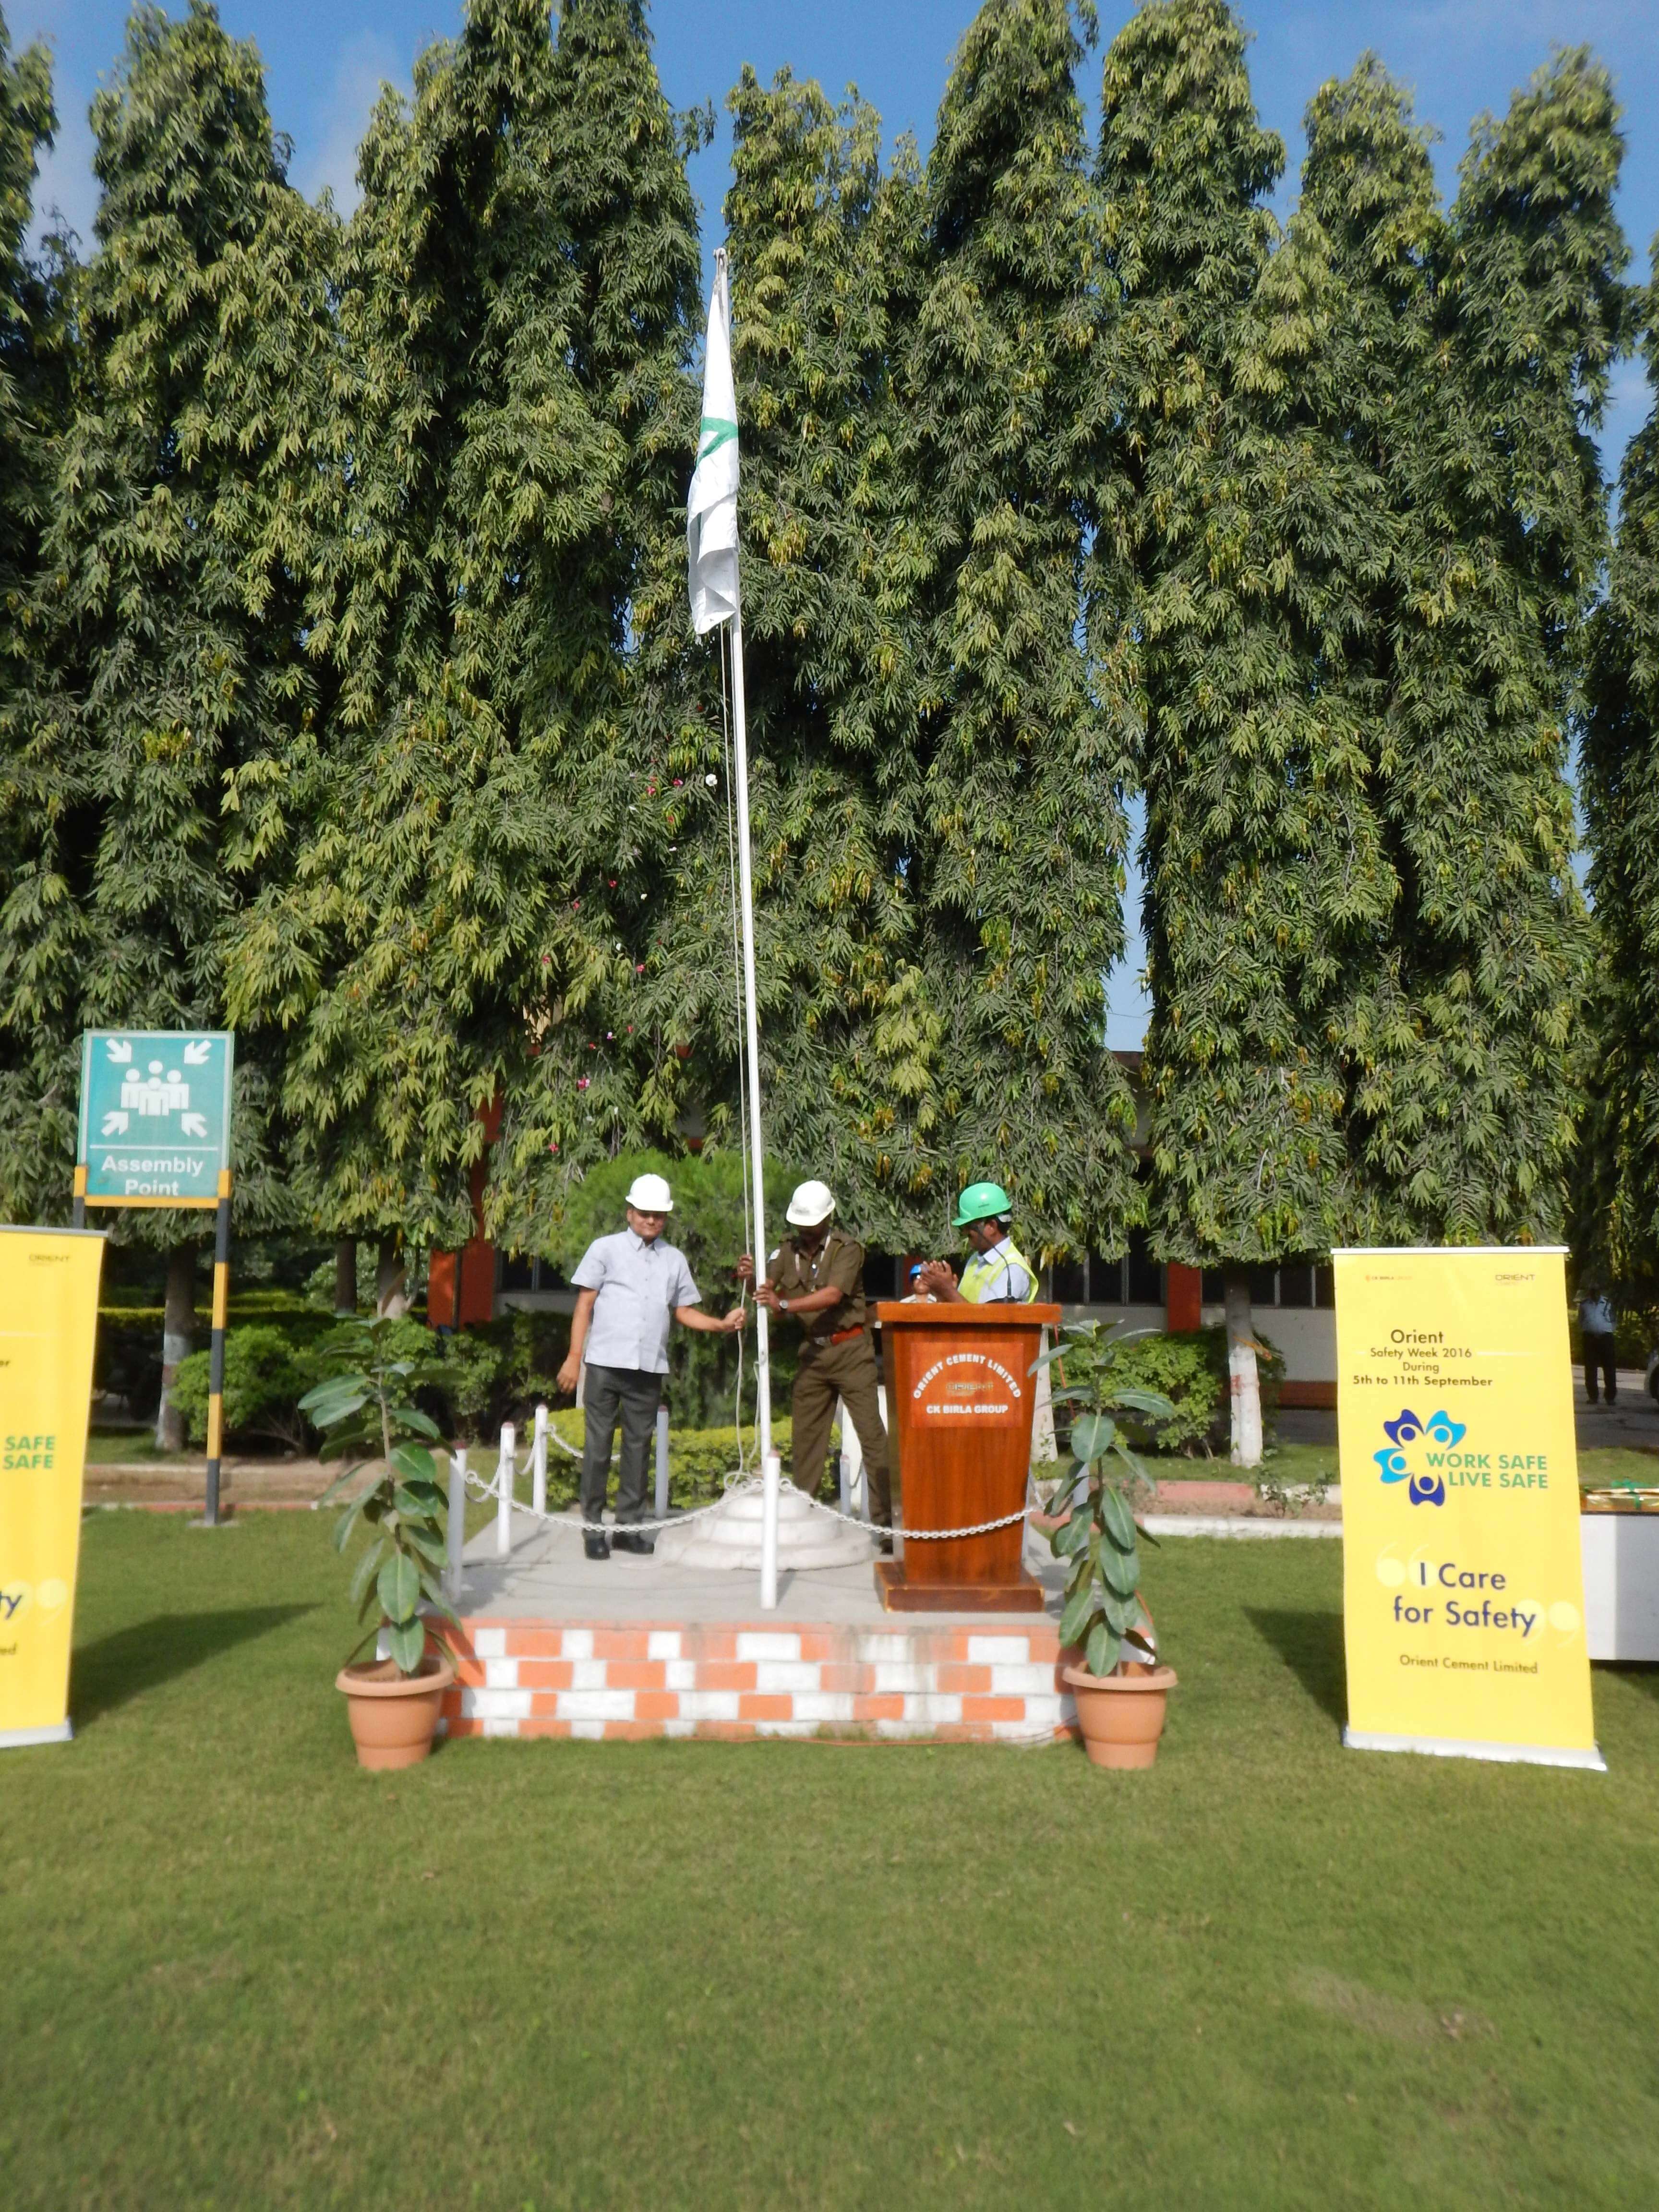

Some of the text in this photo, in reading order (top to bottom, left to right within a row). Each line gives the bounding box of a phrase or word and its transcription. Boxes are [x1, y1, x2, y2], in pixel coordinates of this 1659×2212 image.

[101, 1154, 204, 1177] Assembly
[125, 1179, 179, 1196] Point
[1391, 1330, 1443, 1344] Orient
[1370, 1348, 1472, 1360] Safety Week 2016
[914, 1354, 1022, 1398] ORIENT CEMENT LIMITED
[1403, 1362, 1439, 1374] During
[1353, 1375, 1492, 1388] 5th to 11th September
[926, 1405, 1008, 1414] CK BIRLA GROUP
[5, 1436, 55, 1450] SAFE
[3, 1455, 53, 1469] SAFE
[1426, 1453, 1547, 1470] WORK SAFE
[1449, 1472, 1548, 1488] LIVE SAFE
[1420, 1562, 1506, 1590] I Care
[1394, 1596, 1536, 1637] for Safety
[1399, 1655, 1538, 1673] Orient Cement Limited
